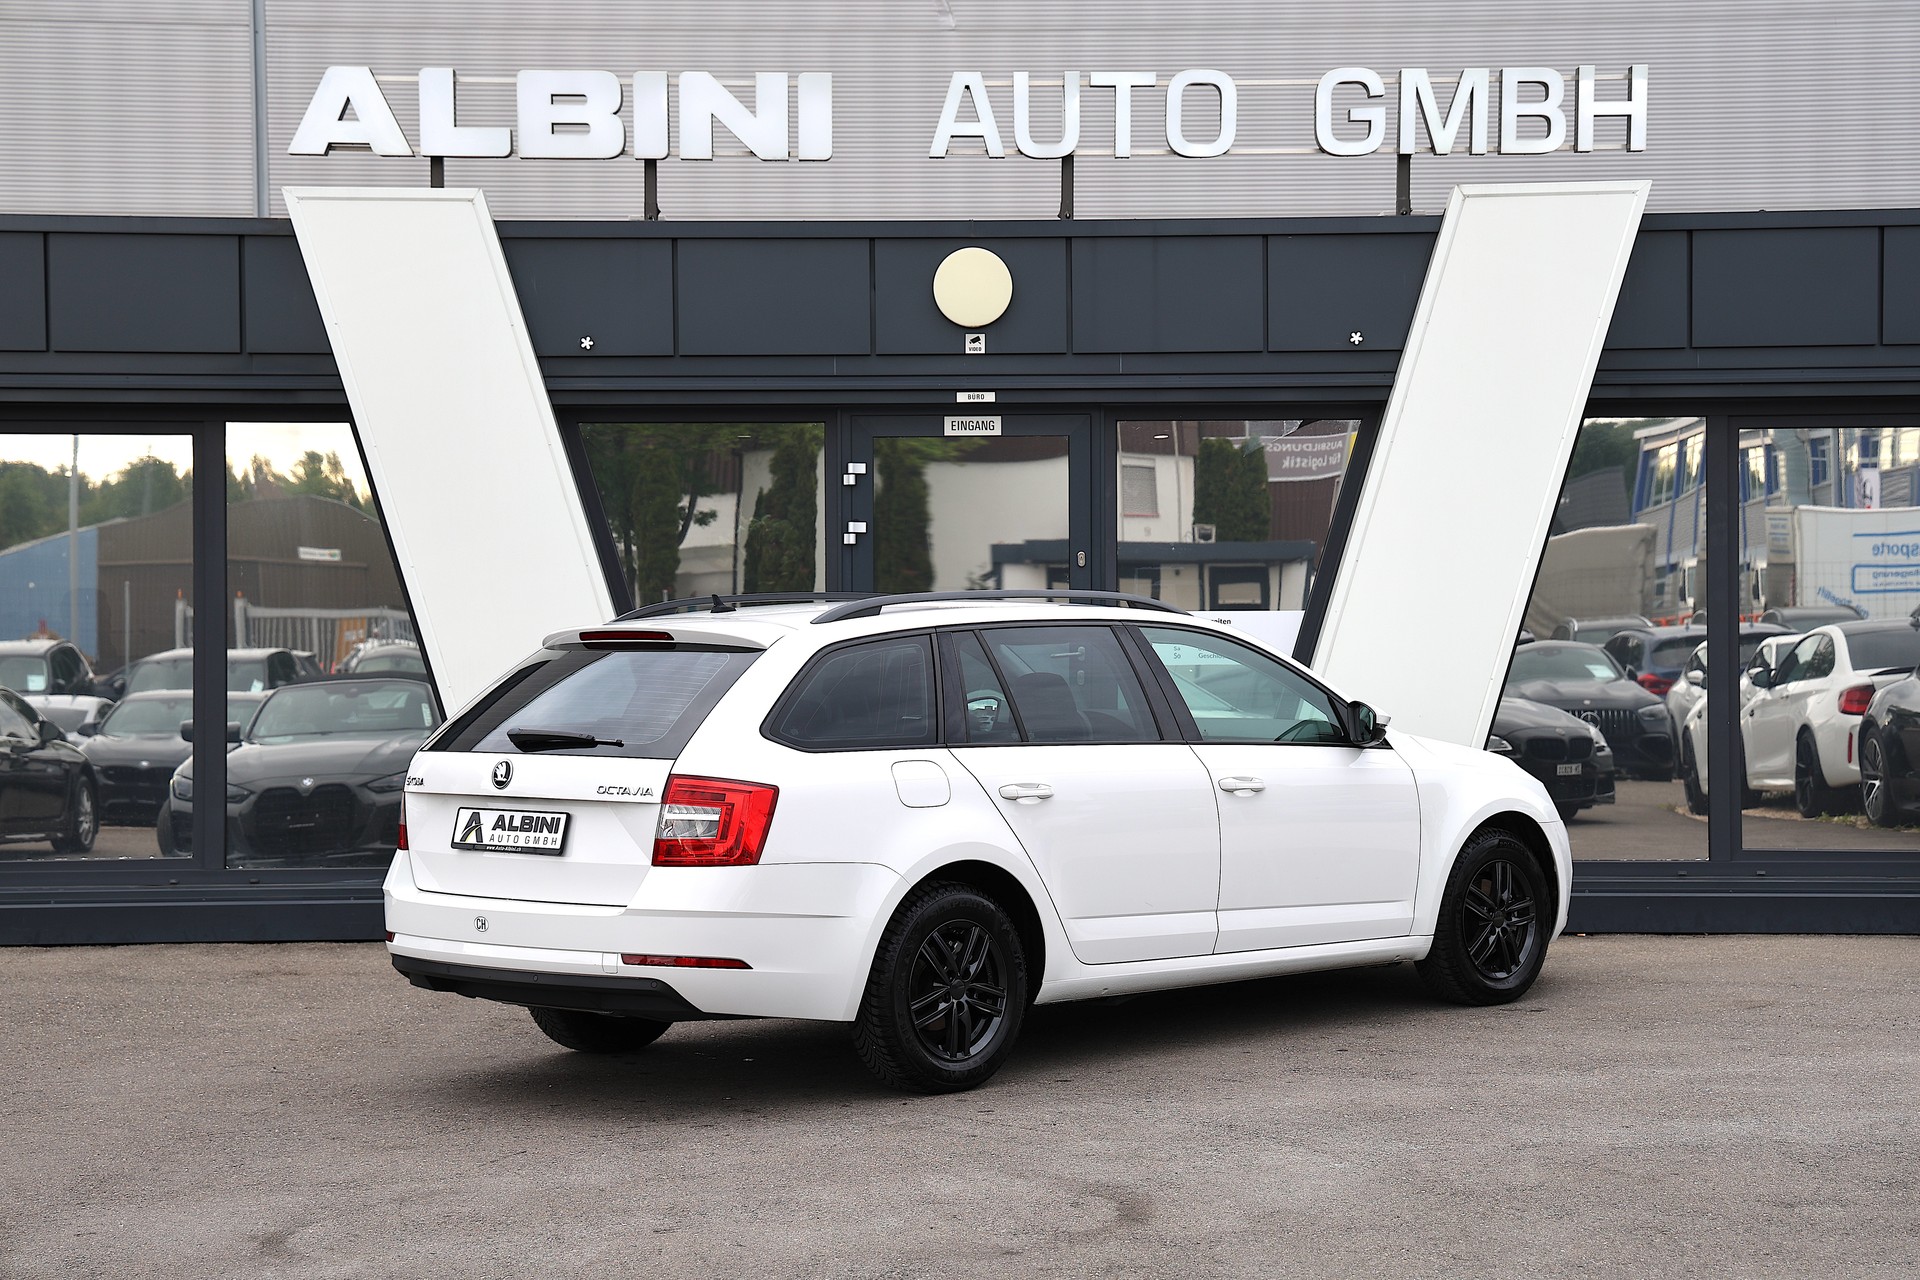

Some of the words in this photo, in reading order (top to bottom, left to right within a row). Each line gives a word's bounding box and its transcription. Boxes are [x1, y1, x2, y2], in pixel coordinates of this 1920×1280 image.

[288, 66, 833, 161] ALBINI
[929, 68, 1239, 159] AUTO
[1315, 64, 1650, 156] GMBH
[950, 420, 995, 431] EINGANG
[1198, 652, 1225, 660] Geschlo
[596, 785, 654, 797] OCTAVIA
[491, 814, 562, 834] ALBINI
[489, 833, 520, 844] AUTO
[524, 835, 558, 846] GMBH
[476, 917, 487, 931] CH
